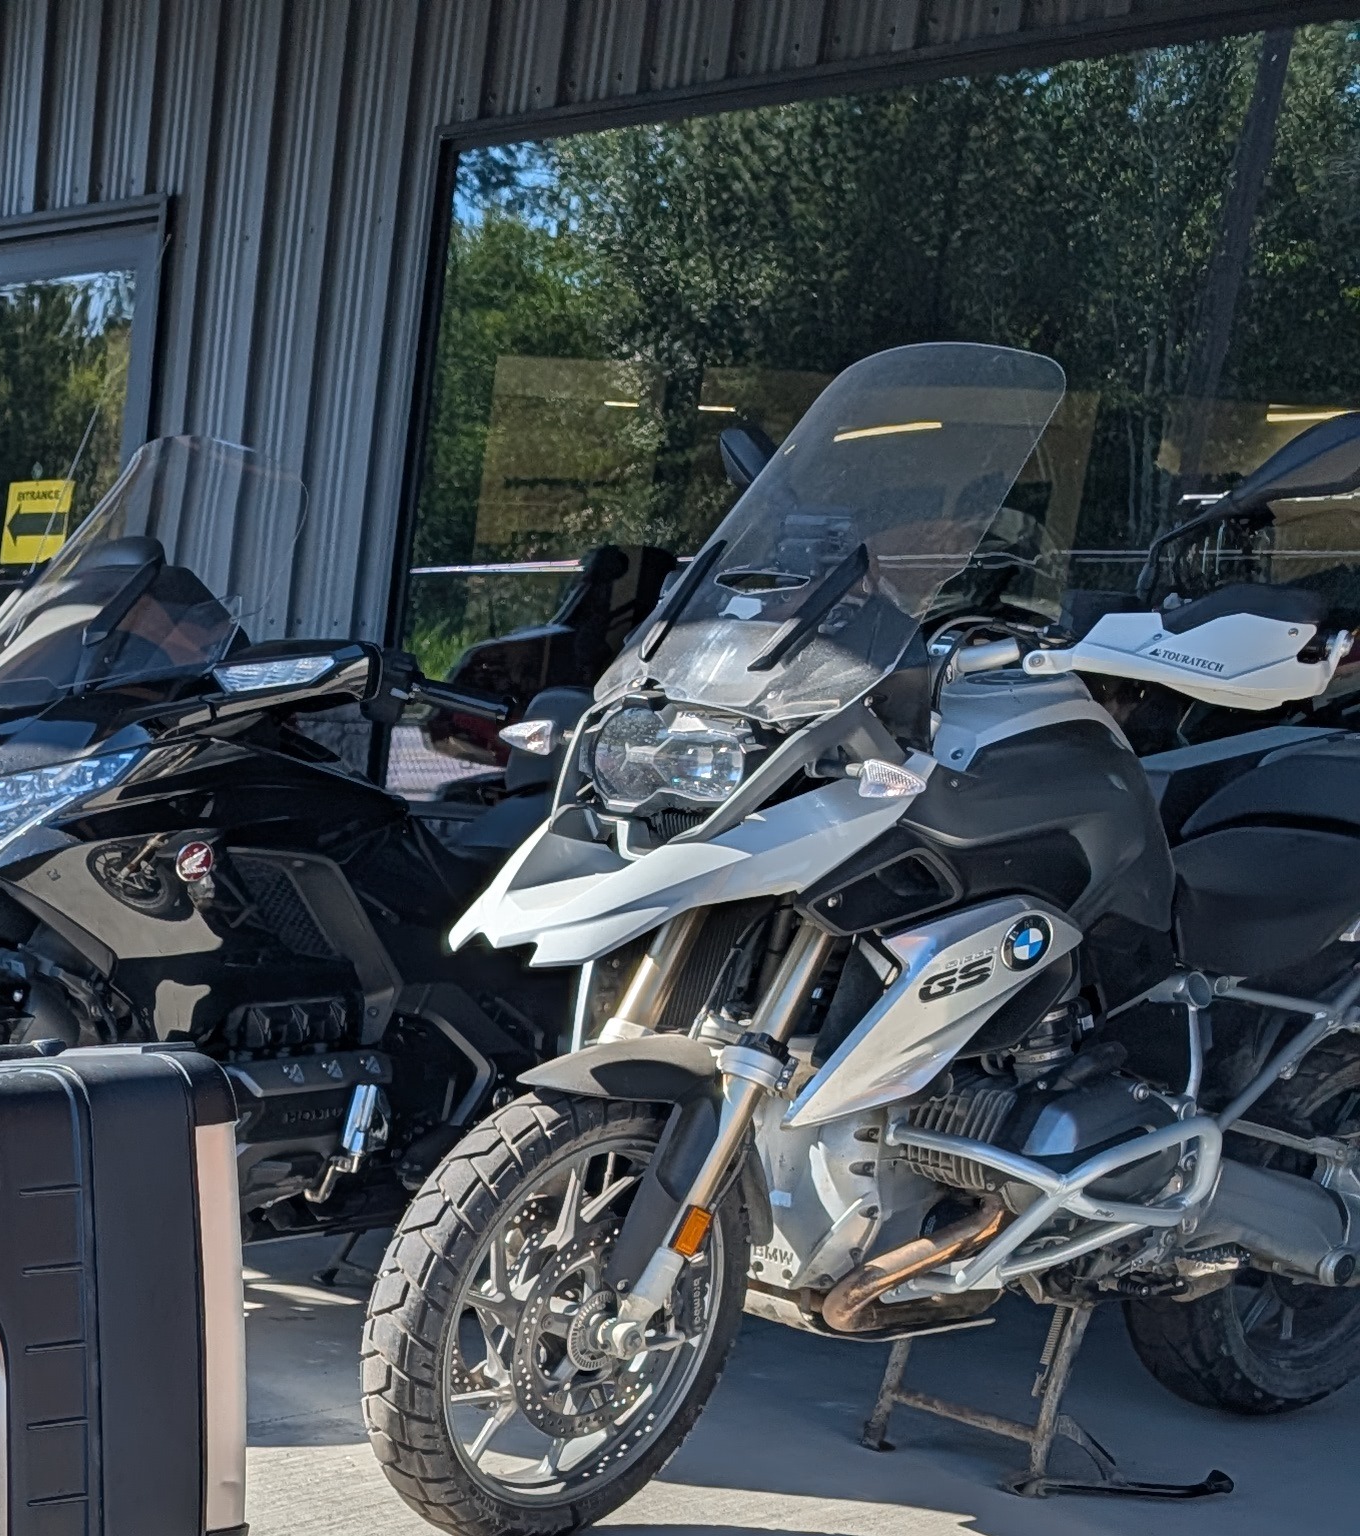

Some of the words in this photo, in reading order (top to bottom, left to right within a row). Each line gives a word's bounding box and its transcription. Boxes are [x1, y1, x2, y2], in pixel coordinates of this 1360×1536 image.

[1162, 649, 1225, 673] TOURATECH
[918, 955, 995, 1003] GS
[754, 1244, 794, 1266] BMW
[693, 1276, 702, 1325] brembo
